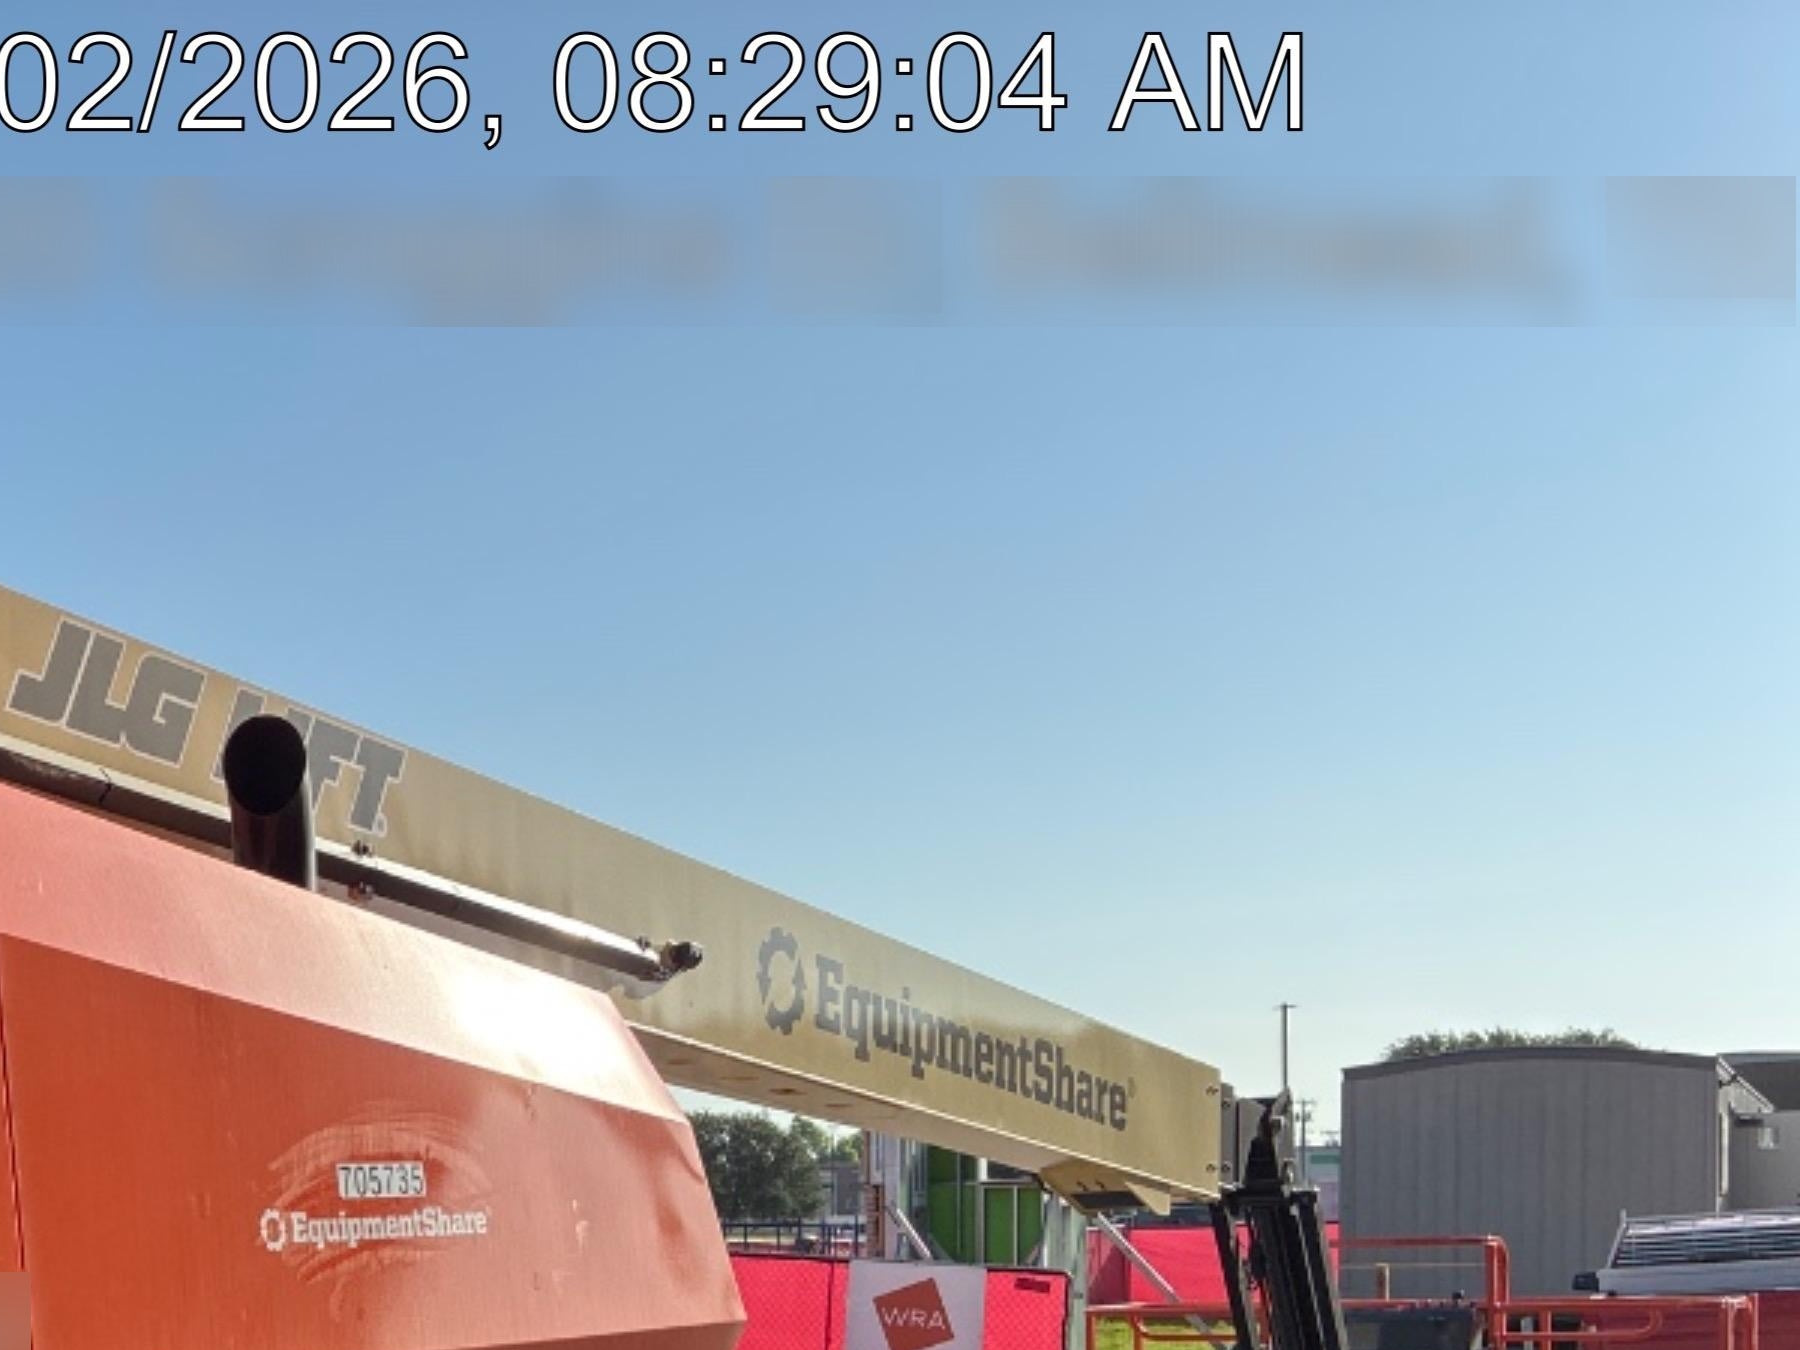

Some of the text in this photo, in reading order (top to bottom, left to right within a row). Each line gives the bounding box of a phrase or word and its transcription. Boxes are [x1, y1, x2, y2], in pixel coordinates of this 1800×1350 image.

[5, 615, 208, 769] JLG
[814, 953, 1128, 1132] EquipmentShare
[338, 1165, 426, 1198] 705735
[291, 1207, 489, 1249] EquipmentShare
[881, 1306, 946, 1331] WRA
